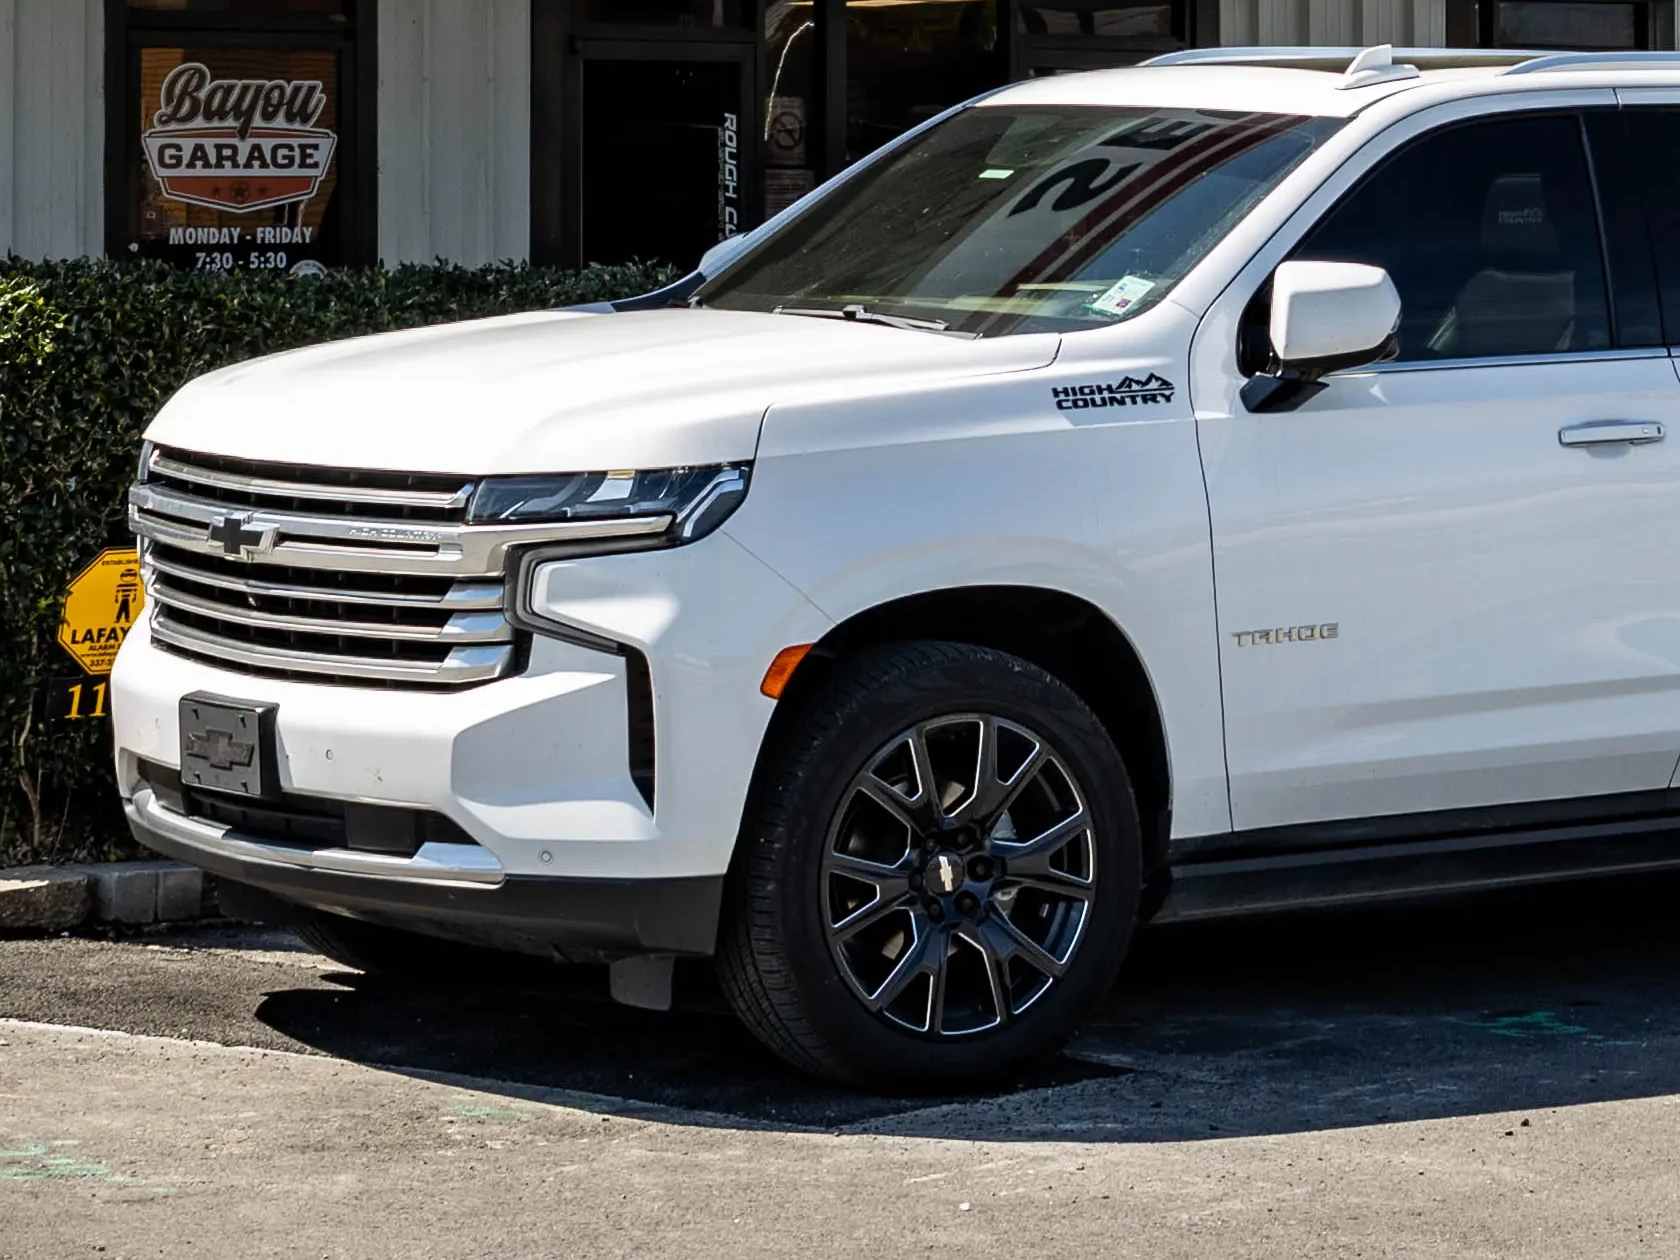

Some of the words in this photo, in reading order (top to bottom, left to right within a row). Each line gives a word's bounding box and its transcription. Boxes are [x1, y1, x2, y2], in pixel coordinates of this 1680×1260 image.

[155, 63, 325, 140] Bayou
[157, 143, 320, 169] GARAGE
[724, 113, 738, 199] ROUGH
[169, 227, 241, 245] MONDAY
[256, 227, 312, 244] FRIDAY
[195, 252, 233, 270] 7:30
[249, 251, 287, 269] 5:30
[1051, 383, 1114, 398] HIGH
[1056, 391, 1175, 410] COUNTRY
[1231, 622, 1339, 647] TAHOE
[63, 681, 108, 719] 11
